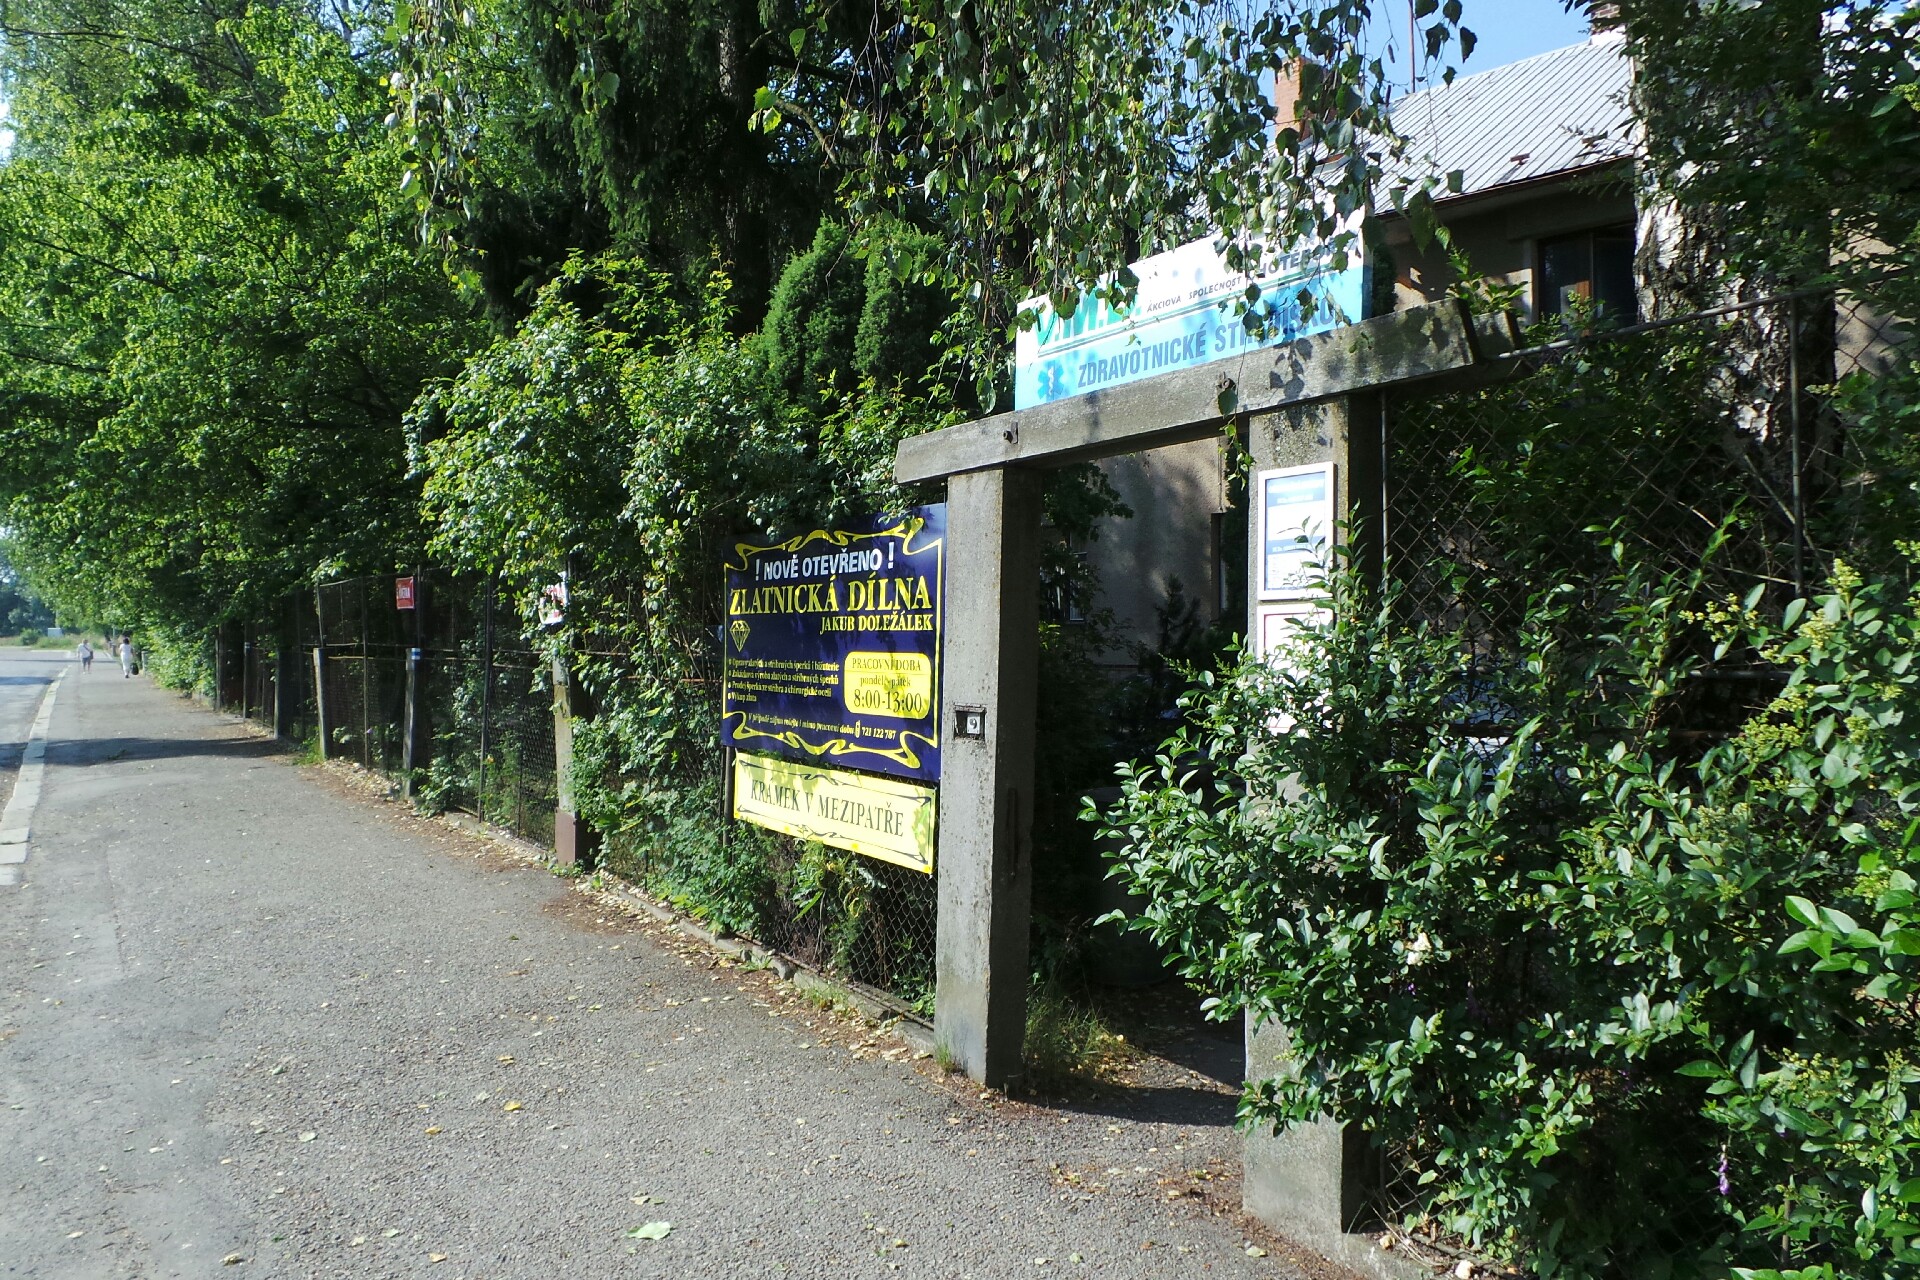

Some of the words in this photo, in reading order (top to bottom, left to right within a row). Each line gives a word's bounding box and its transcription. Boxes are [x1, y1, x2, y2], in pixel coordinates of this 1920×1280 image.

[1077, 322, 1207, 388] ZDRAVOTNICKÉ
[1214, 299, 1334, 353] STDISO
[754, 558, 760, 581] !
[763, 554, 799, 581] NOVĚ
[802, 547, 882, 578] OTEVŘENO
[887, 541, 895, 569] !
[730, 574, 839, 616] ZLATNICKÁ
[847, 571, 933, 611] DÍLNA
[820, 615, 855, 635] JAKUB
[858, 610, 933, 632] DOLEŽÁLEK
[896, 659, 921, 671] DOBA
[750, 777, 800, 812] KRÁMEK
[805, 791, 814, 814] V
[817, 794, 904, 837] MEZIPATŘE
